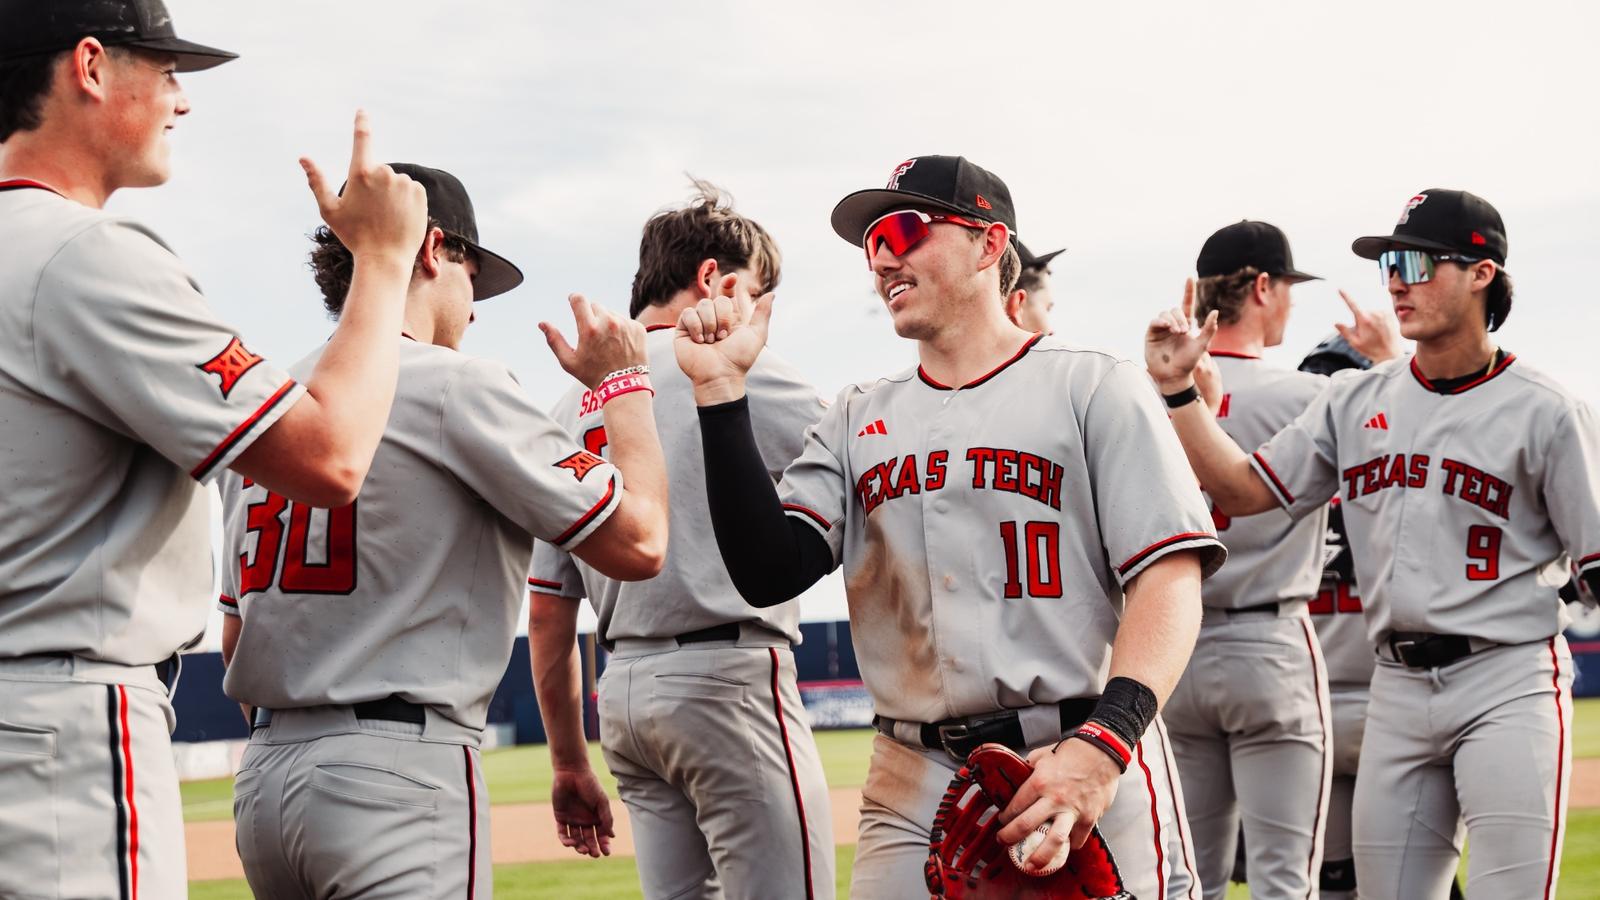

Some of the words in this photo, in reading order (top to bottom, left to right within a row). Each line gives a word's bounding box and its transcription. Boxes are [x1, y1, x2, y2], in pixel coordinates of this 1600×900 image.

[599, 377, 642, 401] TECH
[966, 447, 1065, 512] TECH
[1343, 453, 1430, 501] TEXAS
[1441, 458, 1515, 521] TECH
[239, 476, 358, 597] 30
[1000, 521, 1063, 599] 10
[1466, 524, 1503, 581] 9
